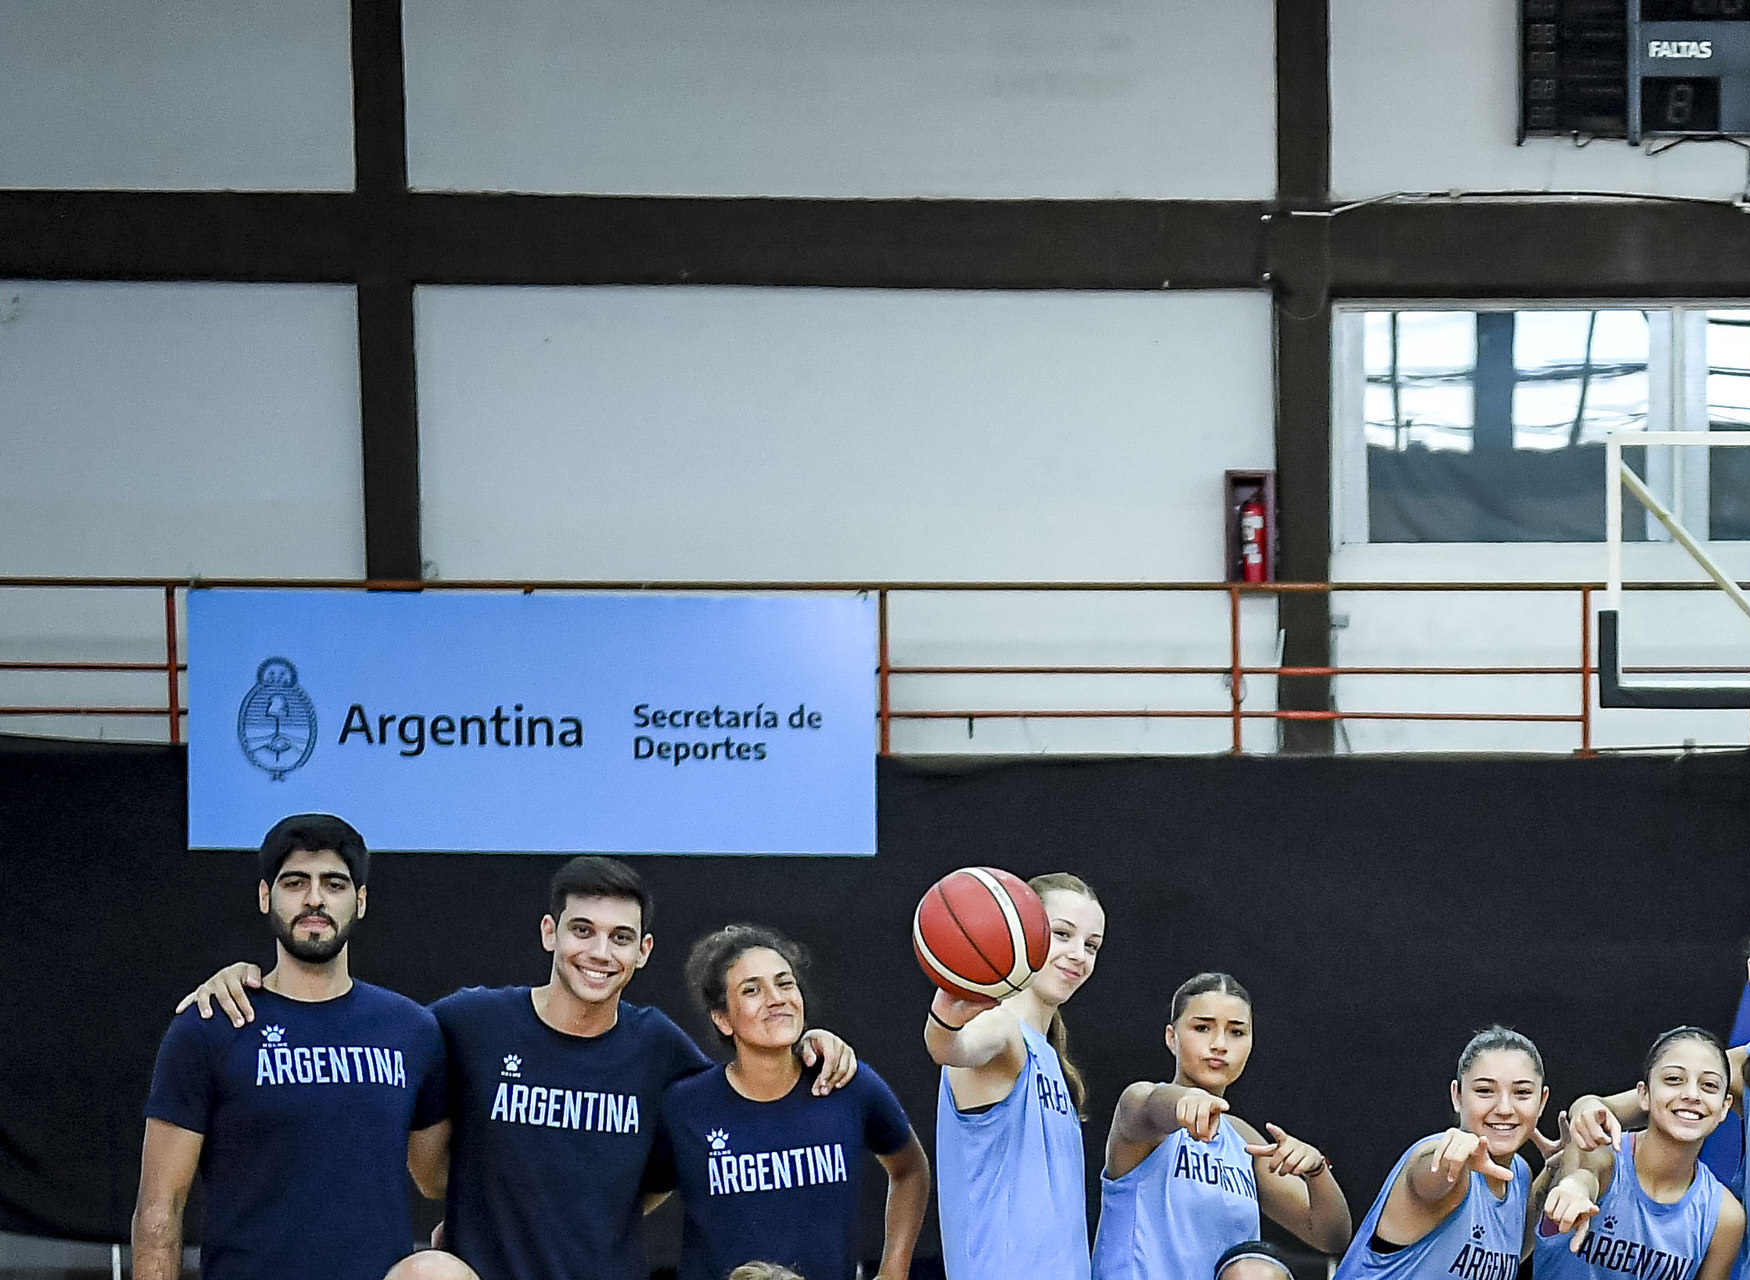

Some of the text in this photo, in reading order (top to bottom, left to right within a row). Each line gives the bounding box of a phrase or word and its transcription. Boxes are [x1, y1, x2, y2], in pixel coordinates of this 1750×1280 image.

[1648, 41, 1712, 58] FALTAS
[339, 703, 584, 757] Argentina
[633, 703, 823, 730] Secretaría de
[633, 736, 767, 766] Deportes
[256, 1047, 406, 1088] ARGENTINA
[491, 1083, 639, 1134] ARGENTINA
[708, 1144, 847, 1195] ARGENTINA
